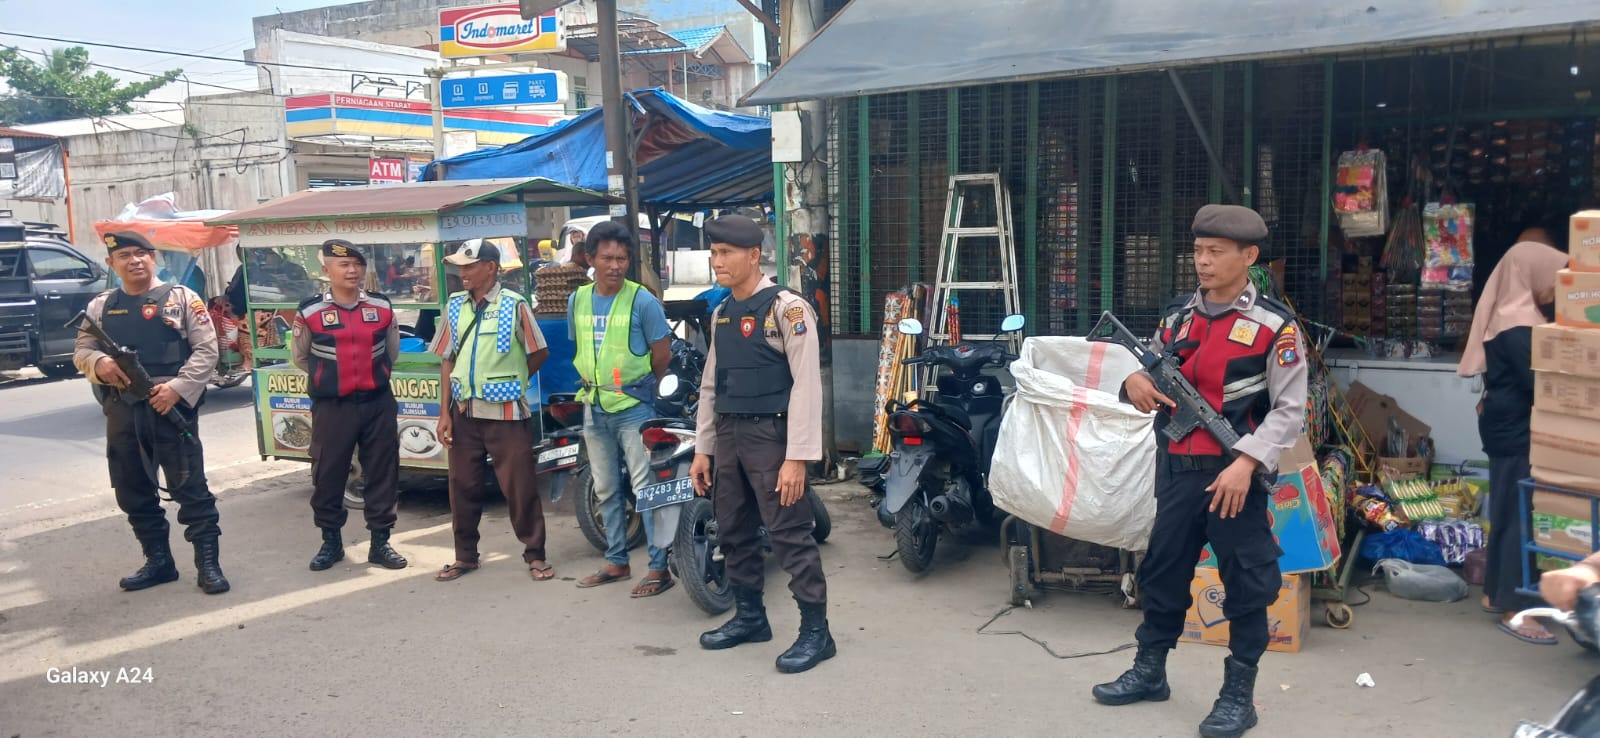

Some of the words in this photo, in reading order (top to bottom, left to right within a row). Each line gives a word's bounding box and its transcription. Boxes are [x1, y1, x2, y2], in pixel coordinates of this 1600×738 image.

[460, 19, 534, 39] Indomaret
[371, 161, 402, 177] ATM
[247, 220, 329, 236] ANEKA
[335, 217, 425, 233] BUBUR
[440, 212, 522, 229] BUBUR
[268, 374, 307, 394] ANEK
